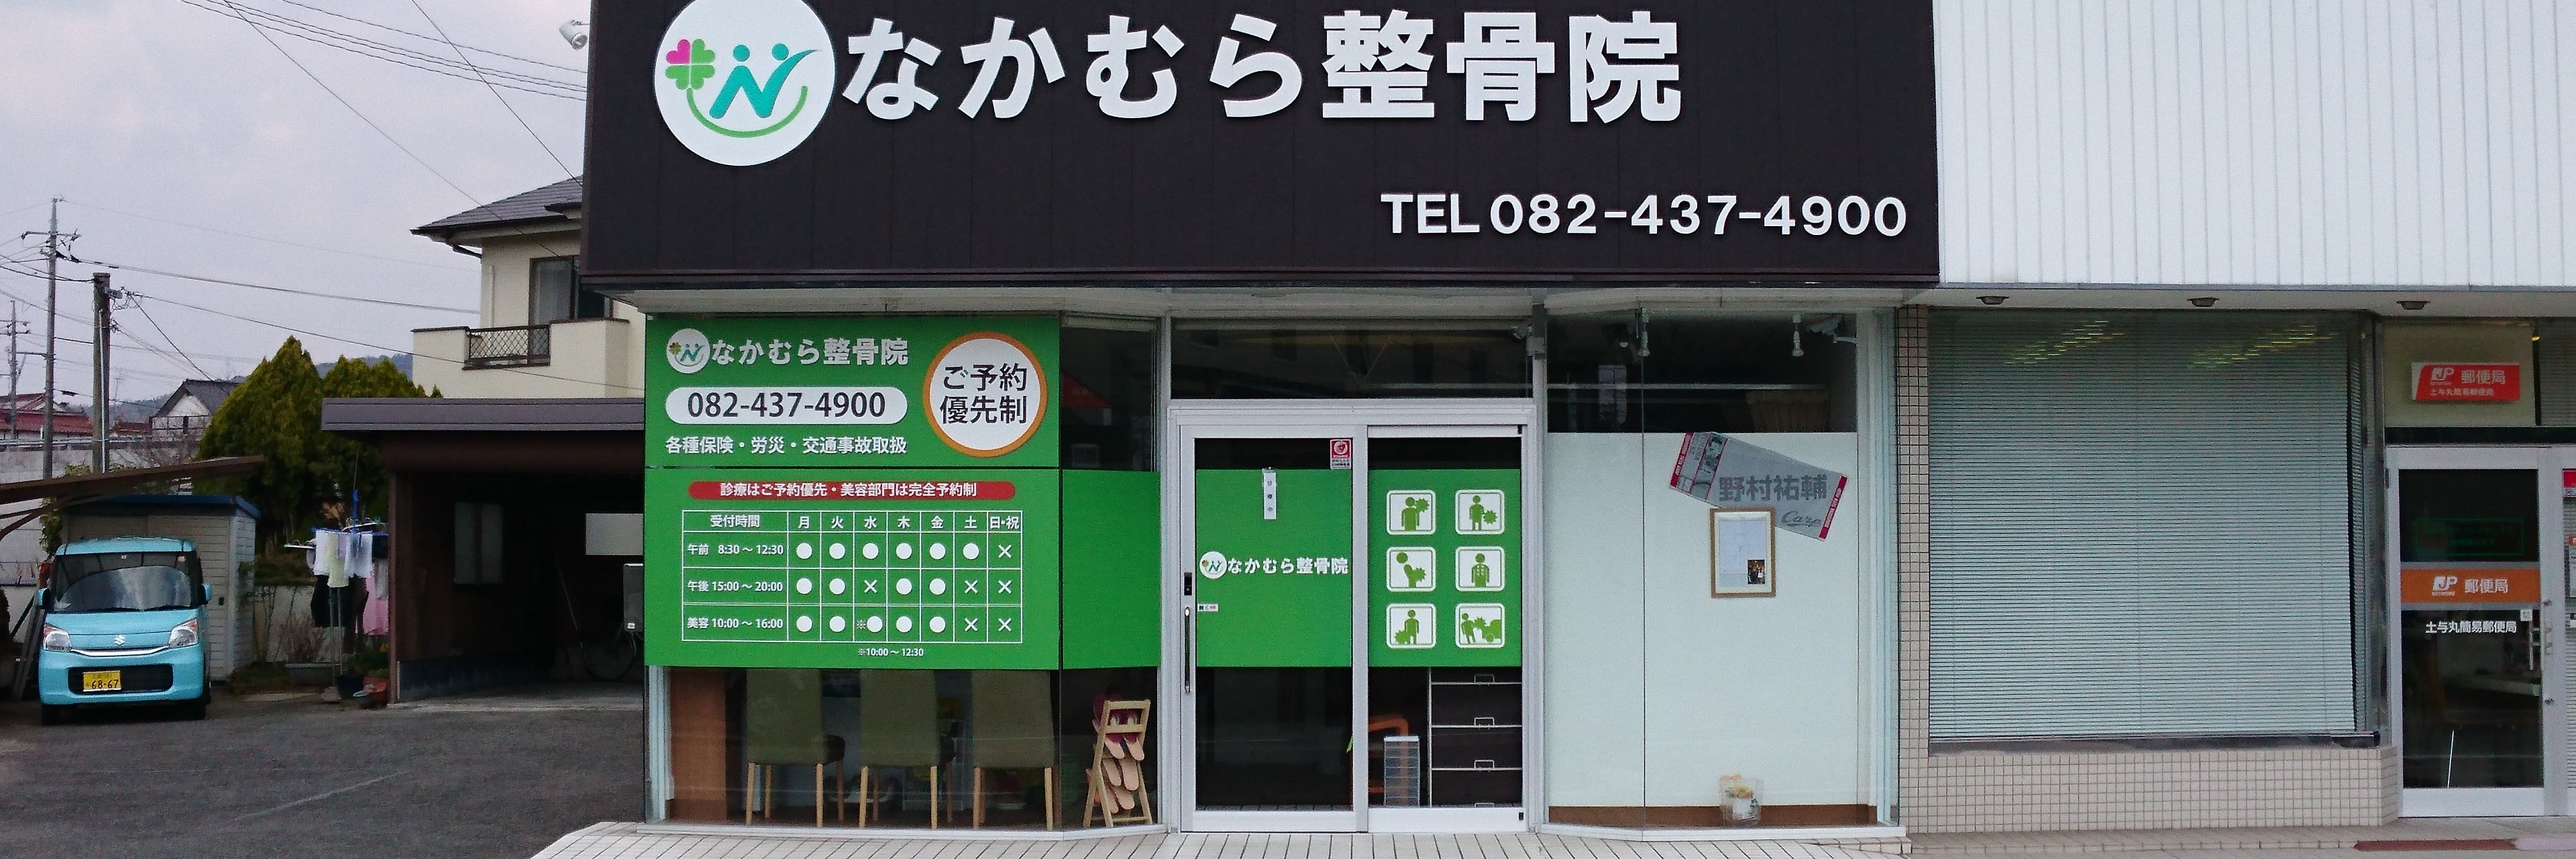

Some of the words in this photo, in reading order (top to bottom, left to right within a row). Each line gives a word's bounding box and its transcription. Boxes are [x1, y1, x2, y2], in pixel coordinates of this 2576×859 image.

[843, 9, 1681, 123] なかむら整骨院
[1381, 193, 1480, 234] TEL
[1490, 193, 1907, 237] 082-437-4900
[712, 338, 908, 365] なかむら整骨院
[943, 363, 1028, 392] ご予約
[2461, 370, 2506, 385] 郵便局
[687, 392, 886, 417] 082-437-4900
[940, 395, 1028, 424] 優先制
[665, 436, 908, 454] 各種保険・労災・交通事故取扱
[720, 483, 977, 497] 診療はご予約優先・美容部門は完全予約制
[1719, 474, 1827, 502] 野村祐輔
[710, 514, 760, 528] 受付時間
[798, 516, 810, 529] 月
[831, 516, 844, 529] 火
[864, 516, 877, 529] 水
[898, 516, 910, 529] 木
[931, 515, 944, 529] 金
[965, 515, 977, 528] 土
[989, 515, 1019, 529] 日・祝
[687, 544, 709, 555] 午前
[718, 544, 740, 554] 8:30
[755, 544, 784, 555] 12:30
[1228, 557, 1348, 574] なかむら整骨院
[687, 580, 709, 592] 午後
[712, 581, 739, 591] 15:00
[755, 581, 783, 592] 20:00
[2465, 579, 2508, 593] 郵便局
[687, 617, 709, 629] 美容
[712, 618, 739, 628] 10:00
[755, 618, 784, 629] 16:00
[2425, 619, 2517, 634] 土与丸簡易郵便局
[91, 679, 119, 689] 68-67
